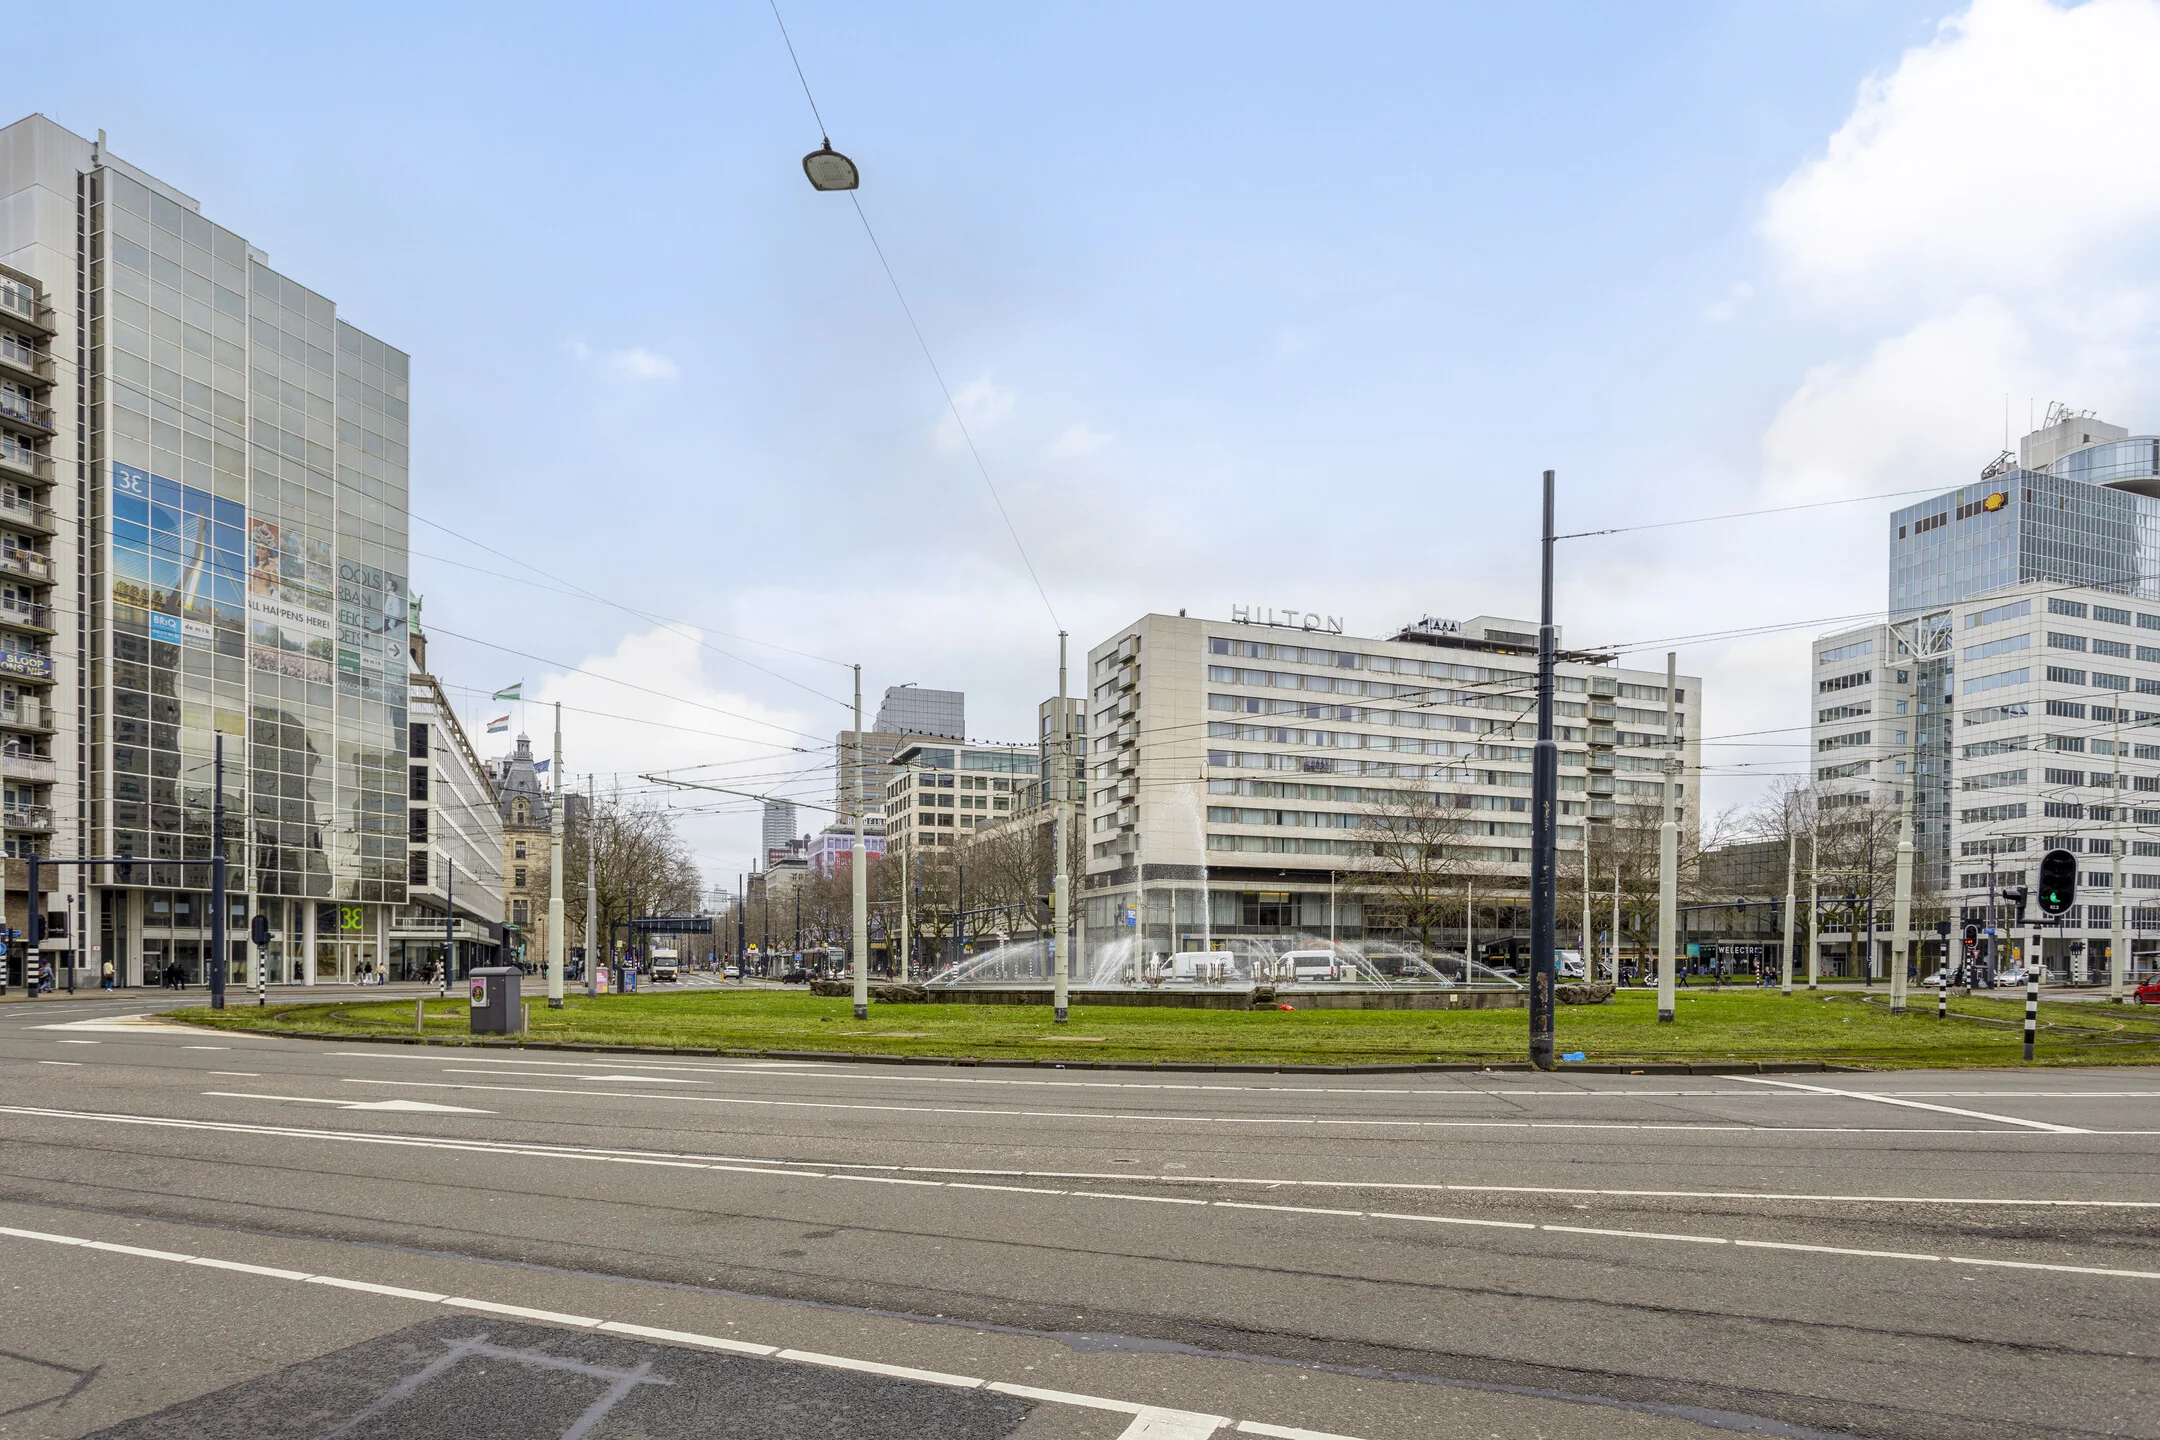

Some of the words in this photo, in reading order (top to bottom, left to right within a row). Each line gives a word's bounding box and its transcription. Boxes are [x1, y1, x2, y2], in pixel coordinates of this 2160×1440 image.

[339, 565, 380, 589] OOLS
[337, 585, 372, 608] RBAN
[262, 603, 304, 623] HAPPENS
[306, 615, 330, 630] HERE!
[1232, 604, 1343, 633] HILTON
[0, 661, 24, 672] ONS
[6, 654, 44, 667] SLOOP
